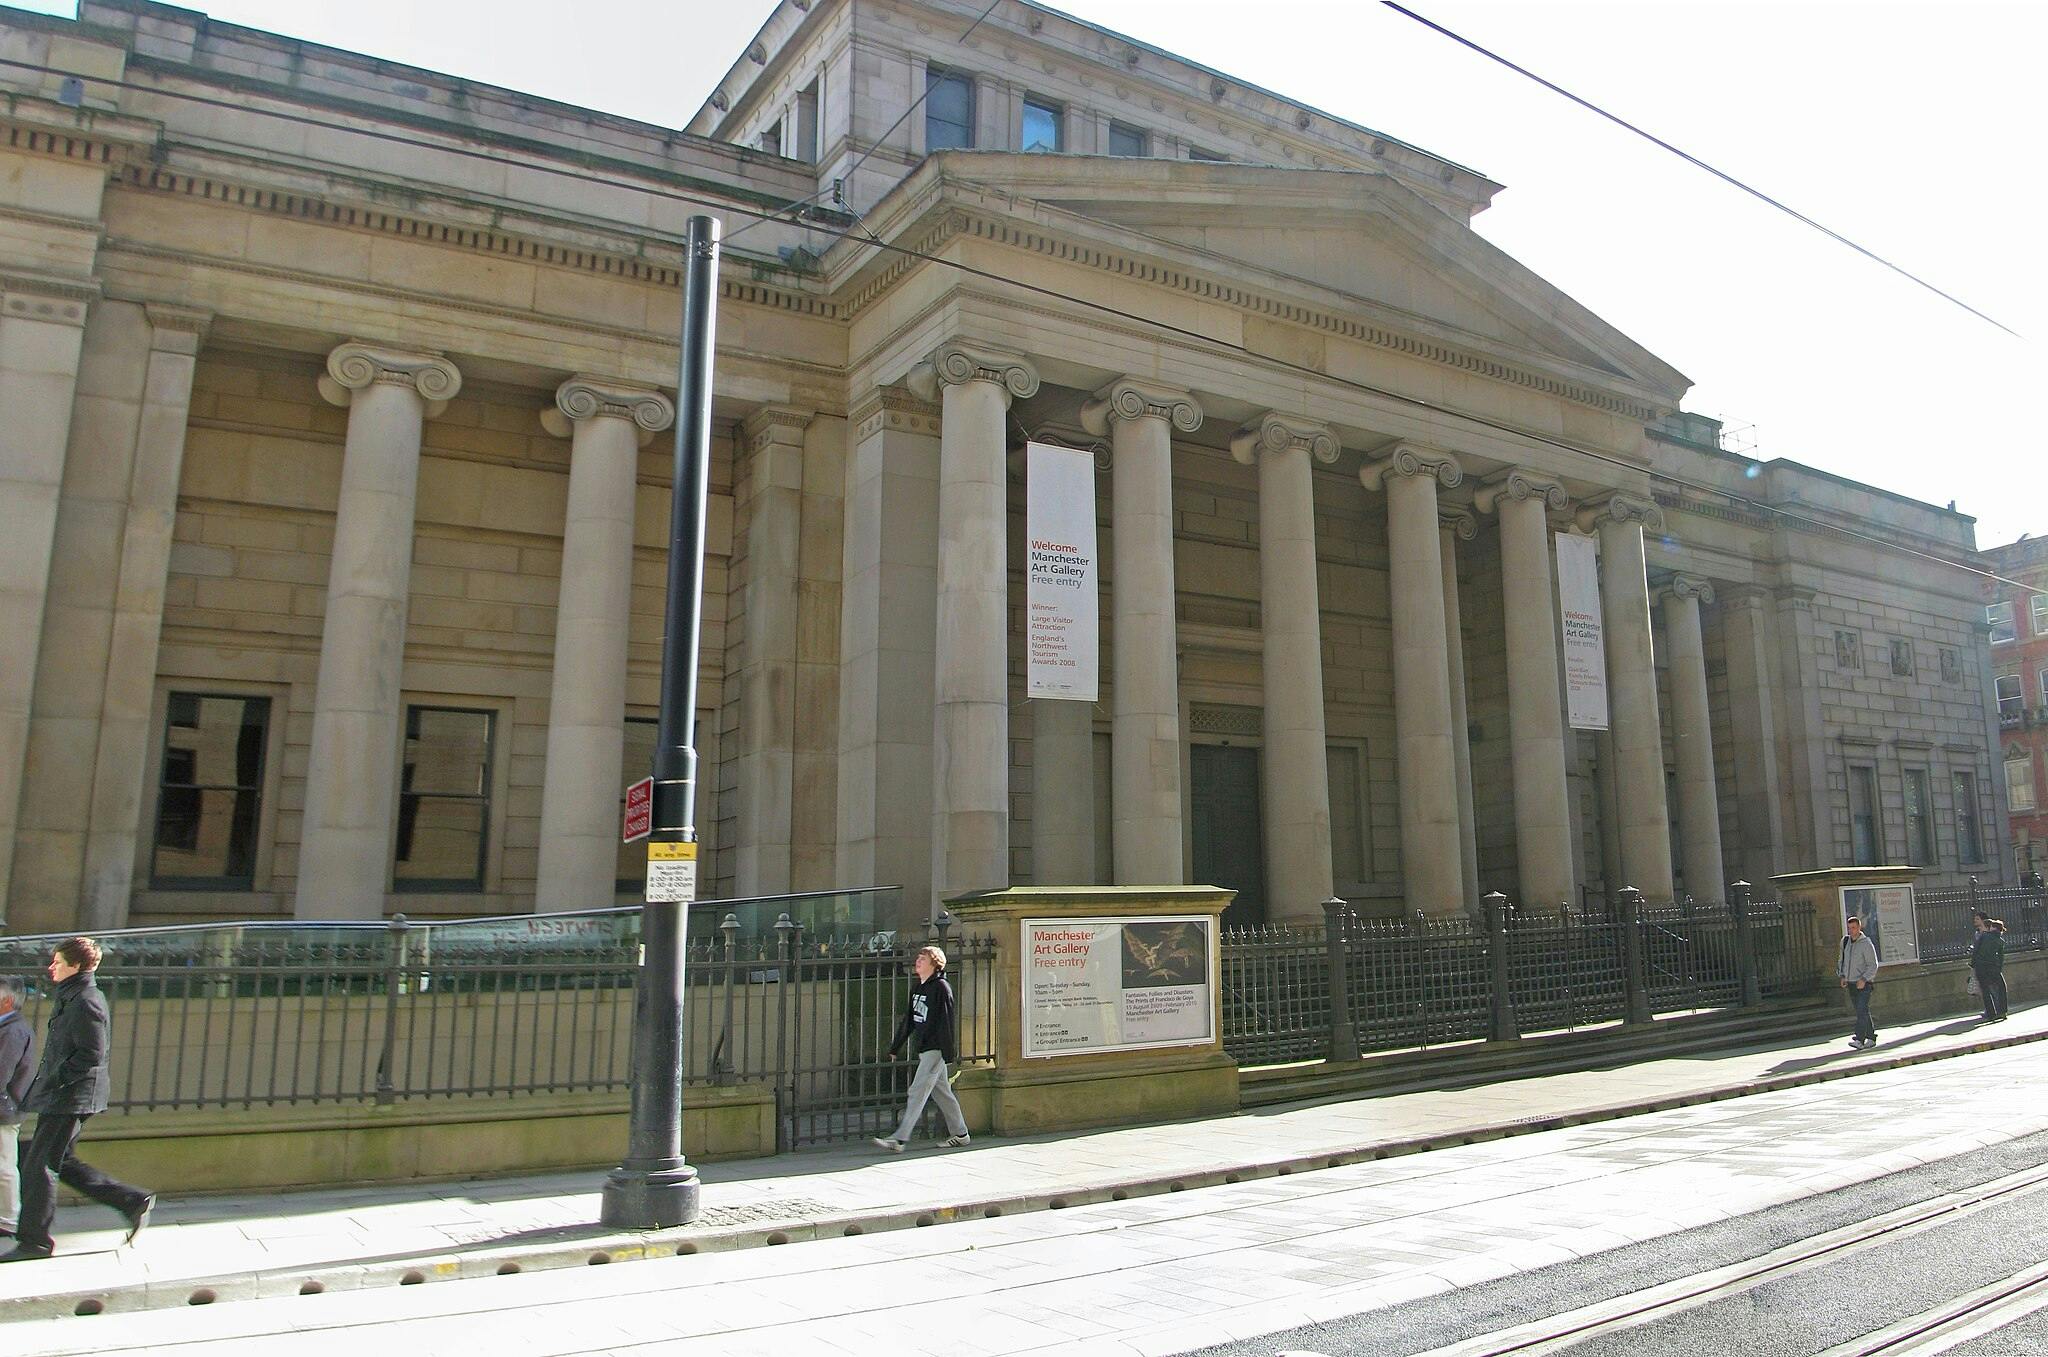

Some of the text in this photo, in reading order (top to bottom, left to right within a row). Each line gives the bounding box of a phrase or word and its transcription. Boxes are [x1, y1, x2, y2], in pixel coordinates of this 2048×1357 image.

[1032, 540, 1077, 553] Welcome
[1032, 552, 1089, 565] Manchester
[1032, 564, 1085, 578] Art Gallery
[1032, 575, 1082, 589] Free entry
[1032, 616, 1074, 624] Large Visitor
[1565, 611, 1592, 620] Welcome
[1566, 620, 1600, 632] Manchester
[1032, 634, 1064, 643] England's
[1579, 630, 1598, 640] Gallery
[1032, 642, 1068, 650] Northwest
[1032, 658, 1058, 666] Awards
[1034, 930, 1095, 941] Manchester
[1034, 944, 1090, 956] Art Gallery
[1034, 958, 1086, 968] Free entry
